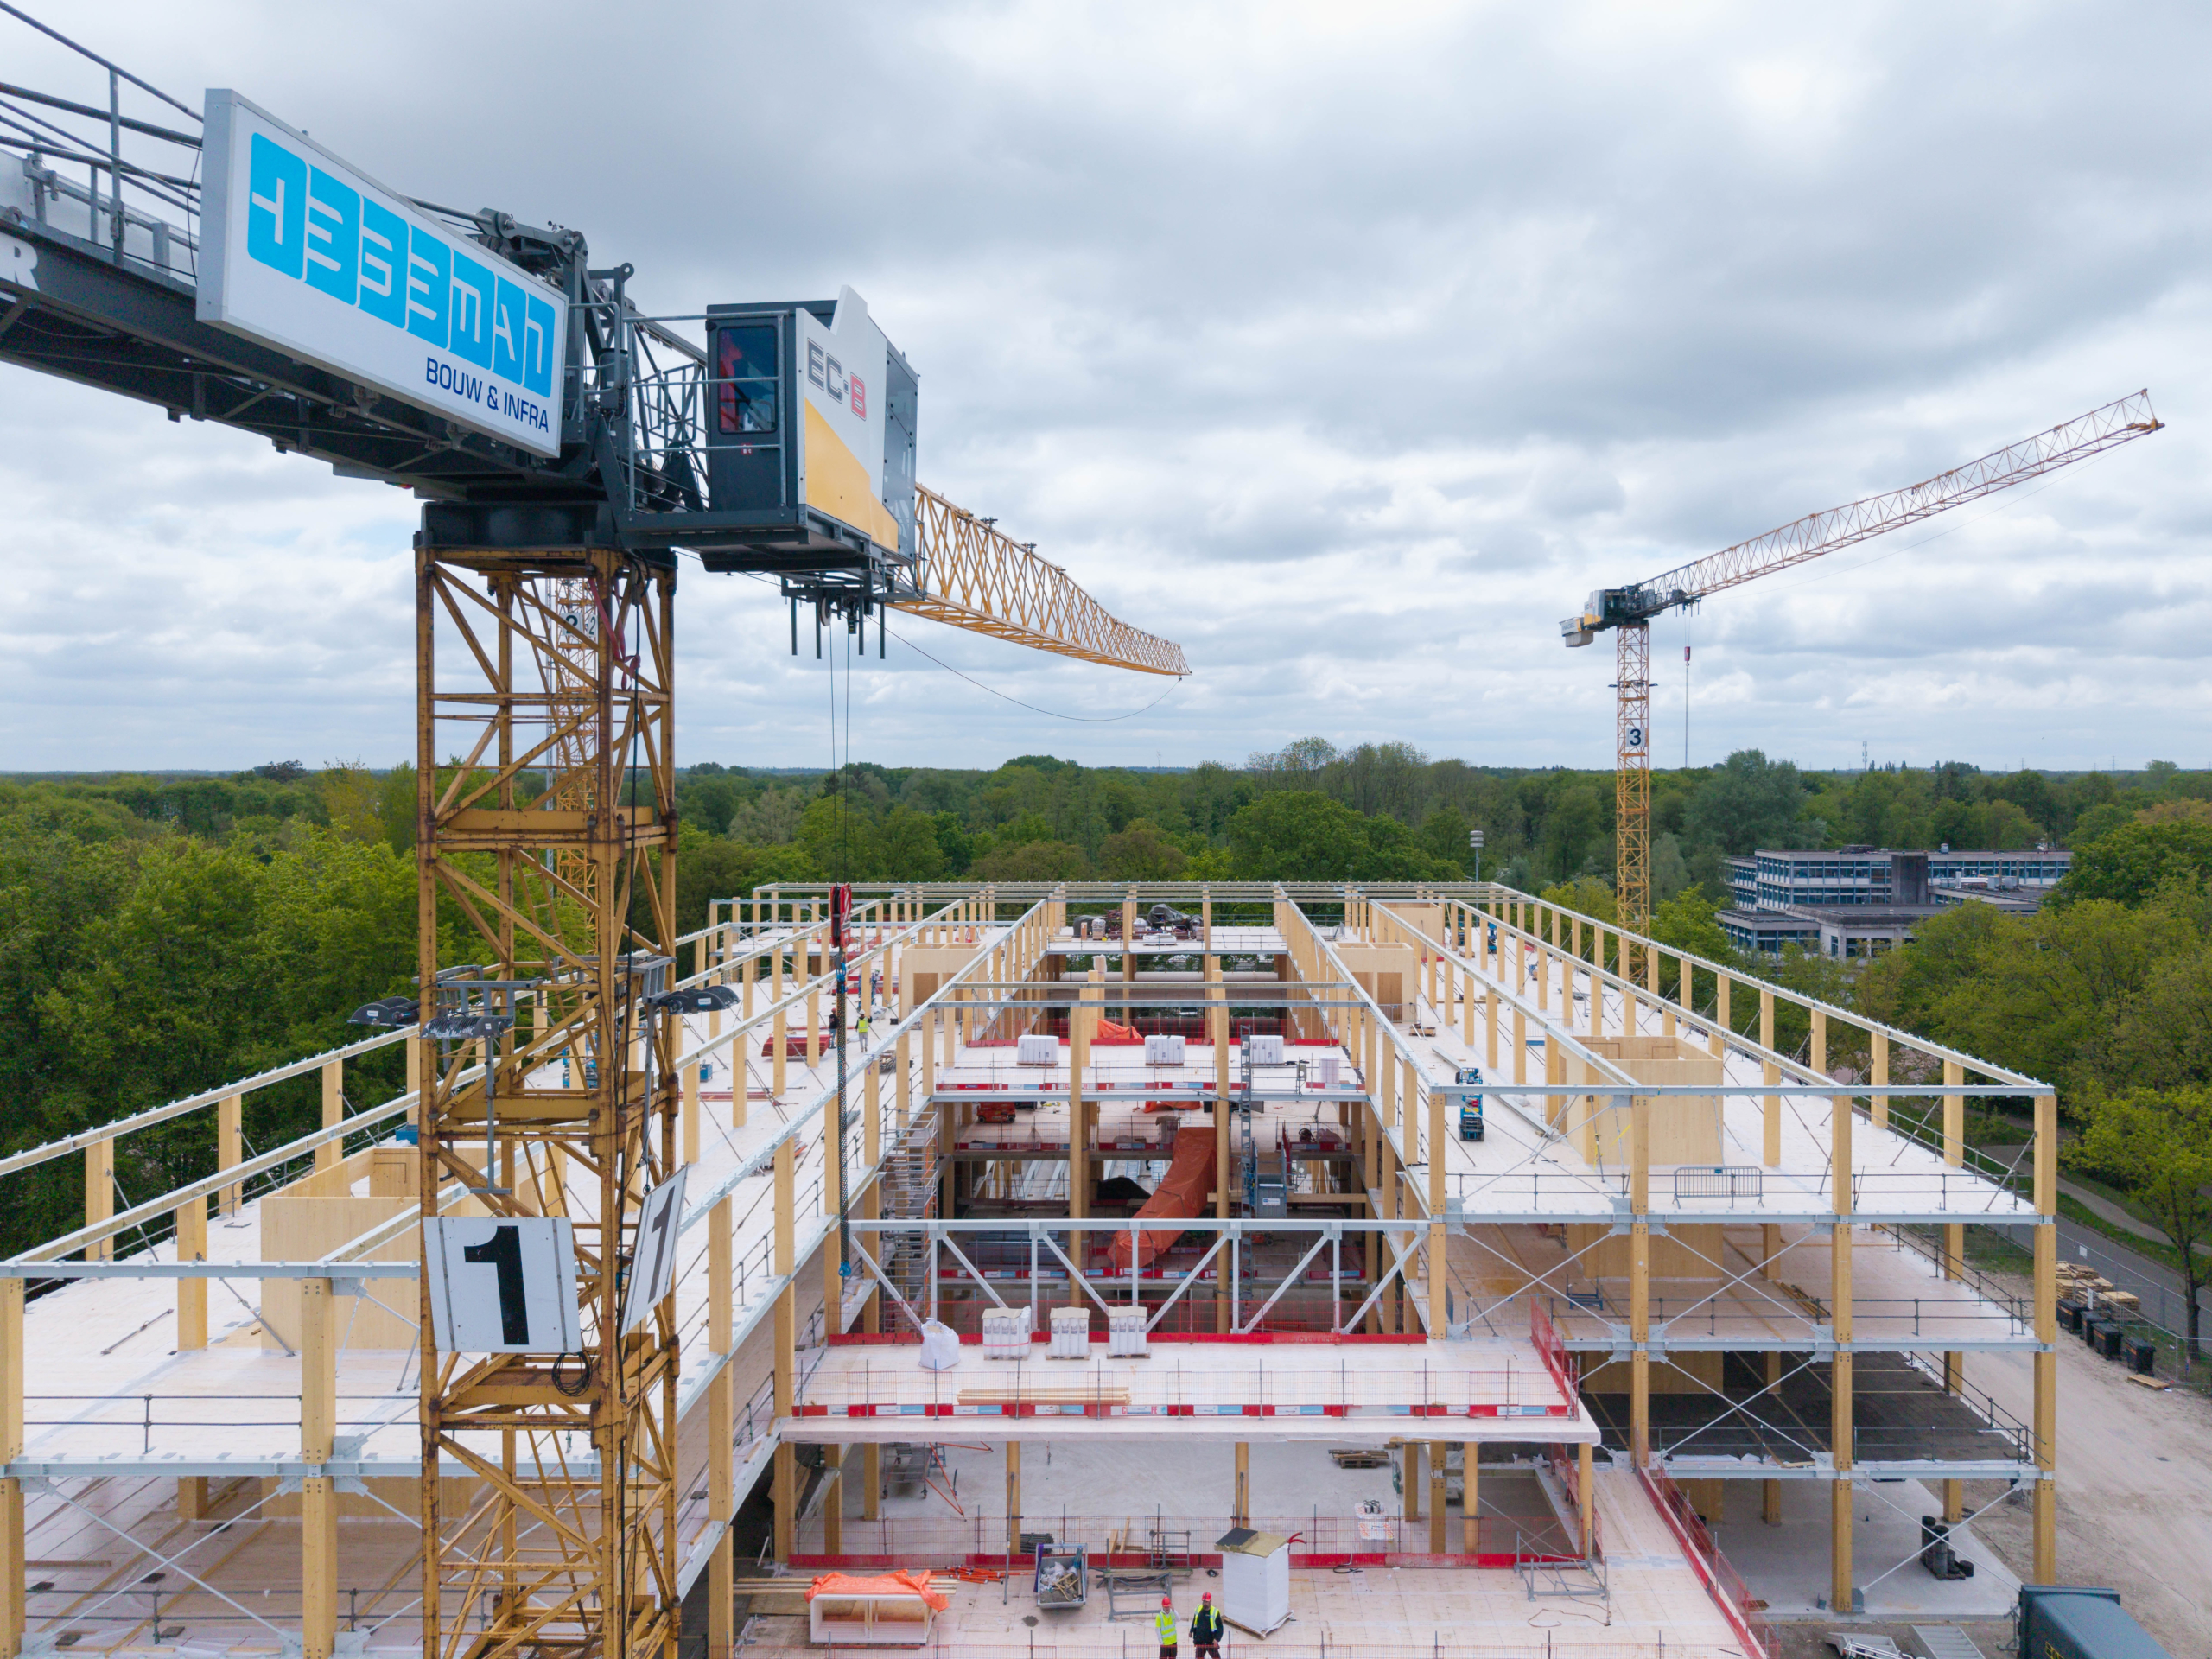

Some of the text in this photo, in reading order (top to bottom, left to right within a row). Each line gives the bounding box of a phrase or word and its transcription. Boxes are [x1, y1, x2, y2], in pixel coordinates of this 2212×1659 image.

[427, 357, 549, 433] BOUW & INFRA
[807, 337, 867, 422] EC-B
[588, 616, 596, 635] 2
[1629, 728, 1642, 747] 3
[647, 1185, 676, 1304] 1
[464, 1225, 530, 1345] 1
